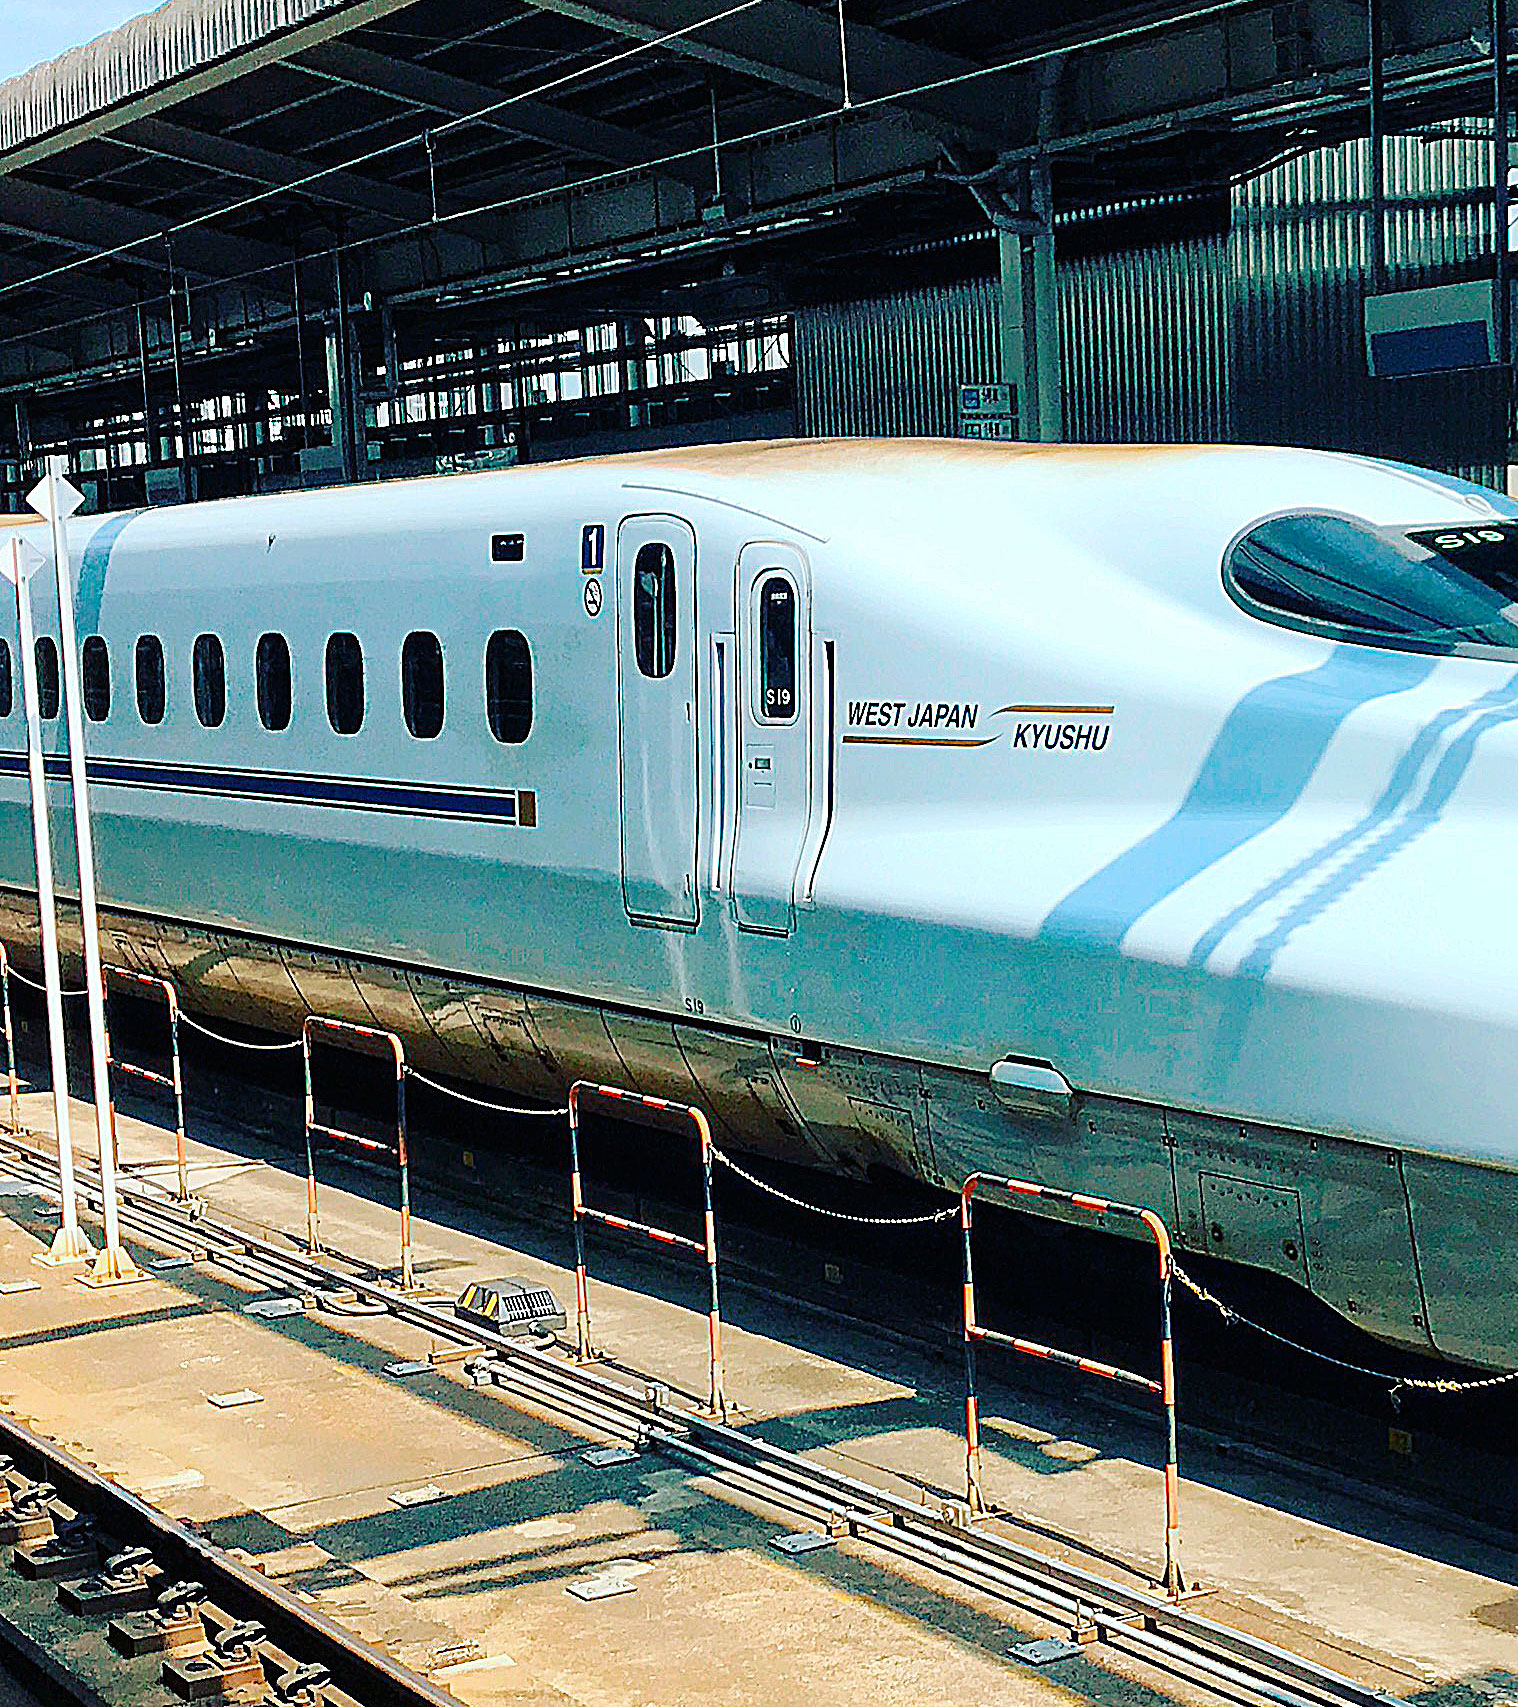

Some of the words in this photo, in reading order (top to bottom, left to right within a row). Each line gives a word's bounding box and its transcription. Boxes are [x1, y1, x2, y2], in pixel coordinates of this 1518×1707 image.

[588, 528, 598, 566] 1
[1435, 530, 1505, 549] S19
[766, 688, 791, 706] S19
[848, 702, 906, 726] WEST
[907, 703, 979, 728] JAPAN
[1013, 724, 1110, 750] KYUSHU
[685, 998, 704, 1014] S19
